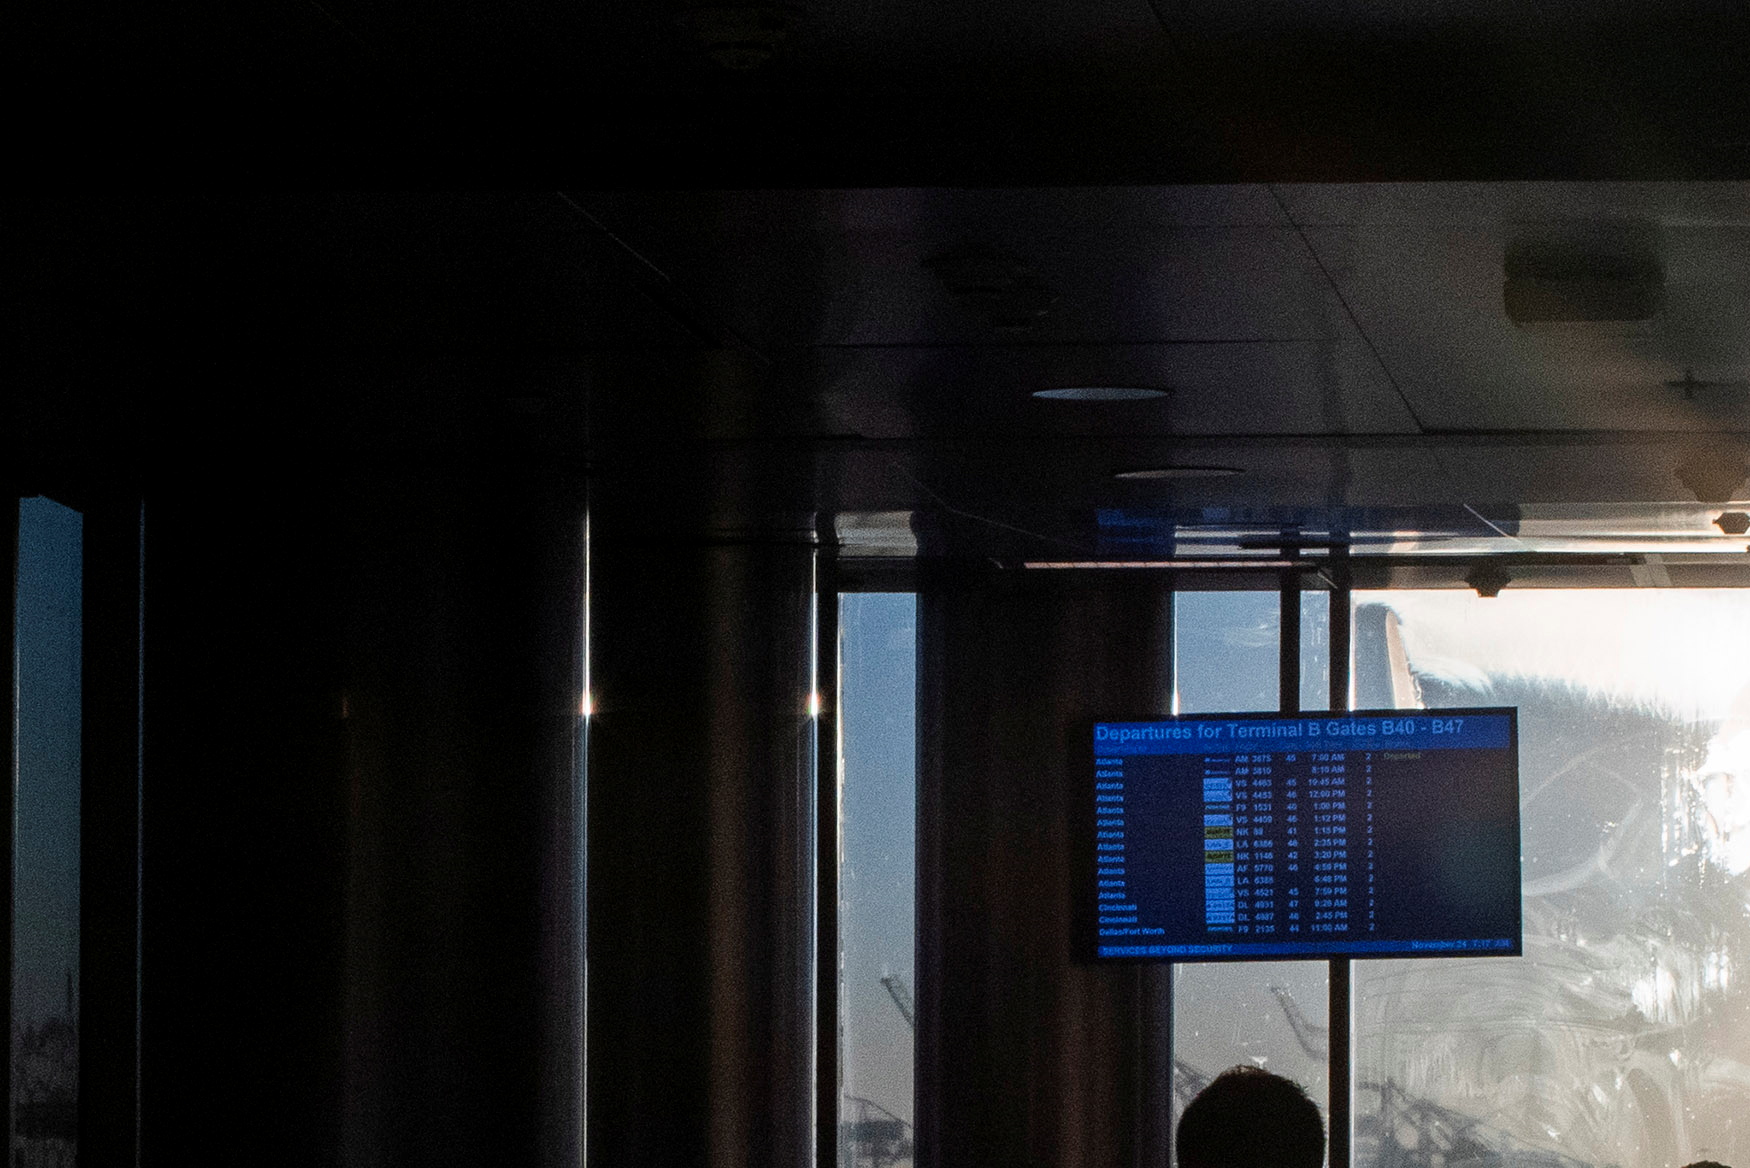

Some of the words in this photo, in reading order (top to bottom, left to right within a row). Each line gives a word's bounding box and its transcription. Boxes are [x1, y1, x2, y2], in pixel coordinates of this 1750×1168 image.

[1096, 725, 1192, 744] Departures
[1198, 725, 1223, 739] for
[1229, 722, 1303, 738] Terminal
[1308, 721, 1321, 737] B
[1326, 721, 1376, 737] Gates
[1382, 720, 1414, 736] B40
[1432, 719, 1464, 735] B47
[1095, 758, 1123, 766] Atlanta
[1095, 770, 1123, 778] Atlanta
[1095, 782, 1123, 790] Atlanta
[1096, 794, 1124, 803] Atlanta
[1096, 806, 1124, 815] Atlanta
[1096, 819, 1124, 827] Atlanta
[1097, 831, 1124, 839] Atlanta
[1097, 843, 1124, 851] Atlanta
[1097, 855, 1125, 863] Atlanta
[1097, 867, 1125, 876] Atlanta
[1098, 880, 1125, 888] Atlanta
[1098, 892, 1125, 900] Atlanta
[1099, 903, 1137, 912] Cincinnati
[1099, 916, 1137, 924] Cincinnati
[1143, 927, 1165, 935] Worth
[1102, 946, 1147, 956] SERVICES
[1148, 945, 1187, 954] BEYOND
[1188, 944, 1234, 954] SECURITY
